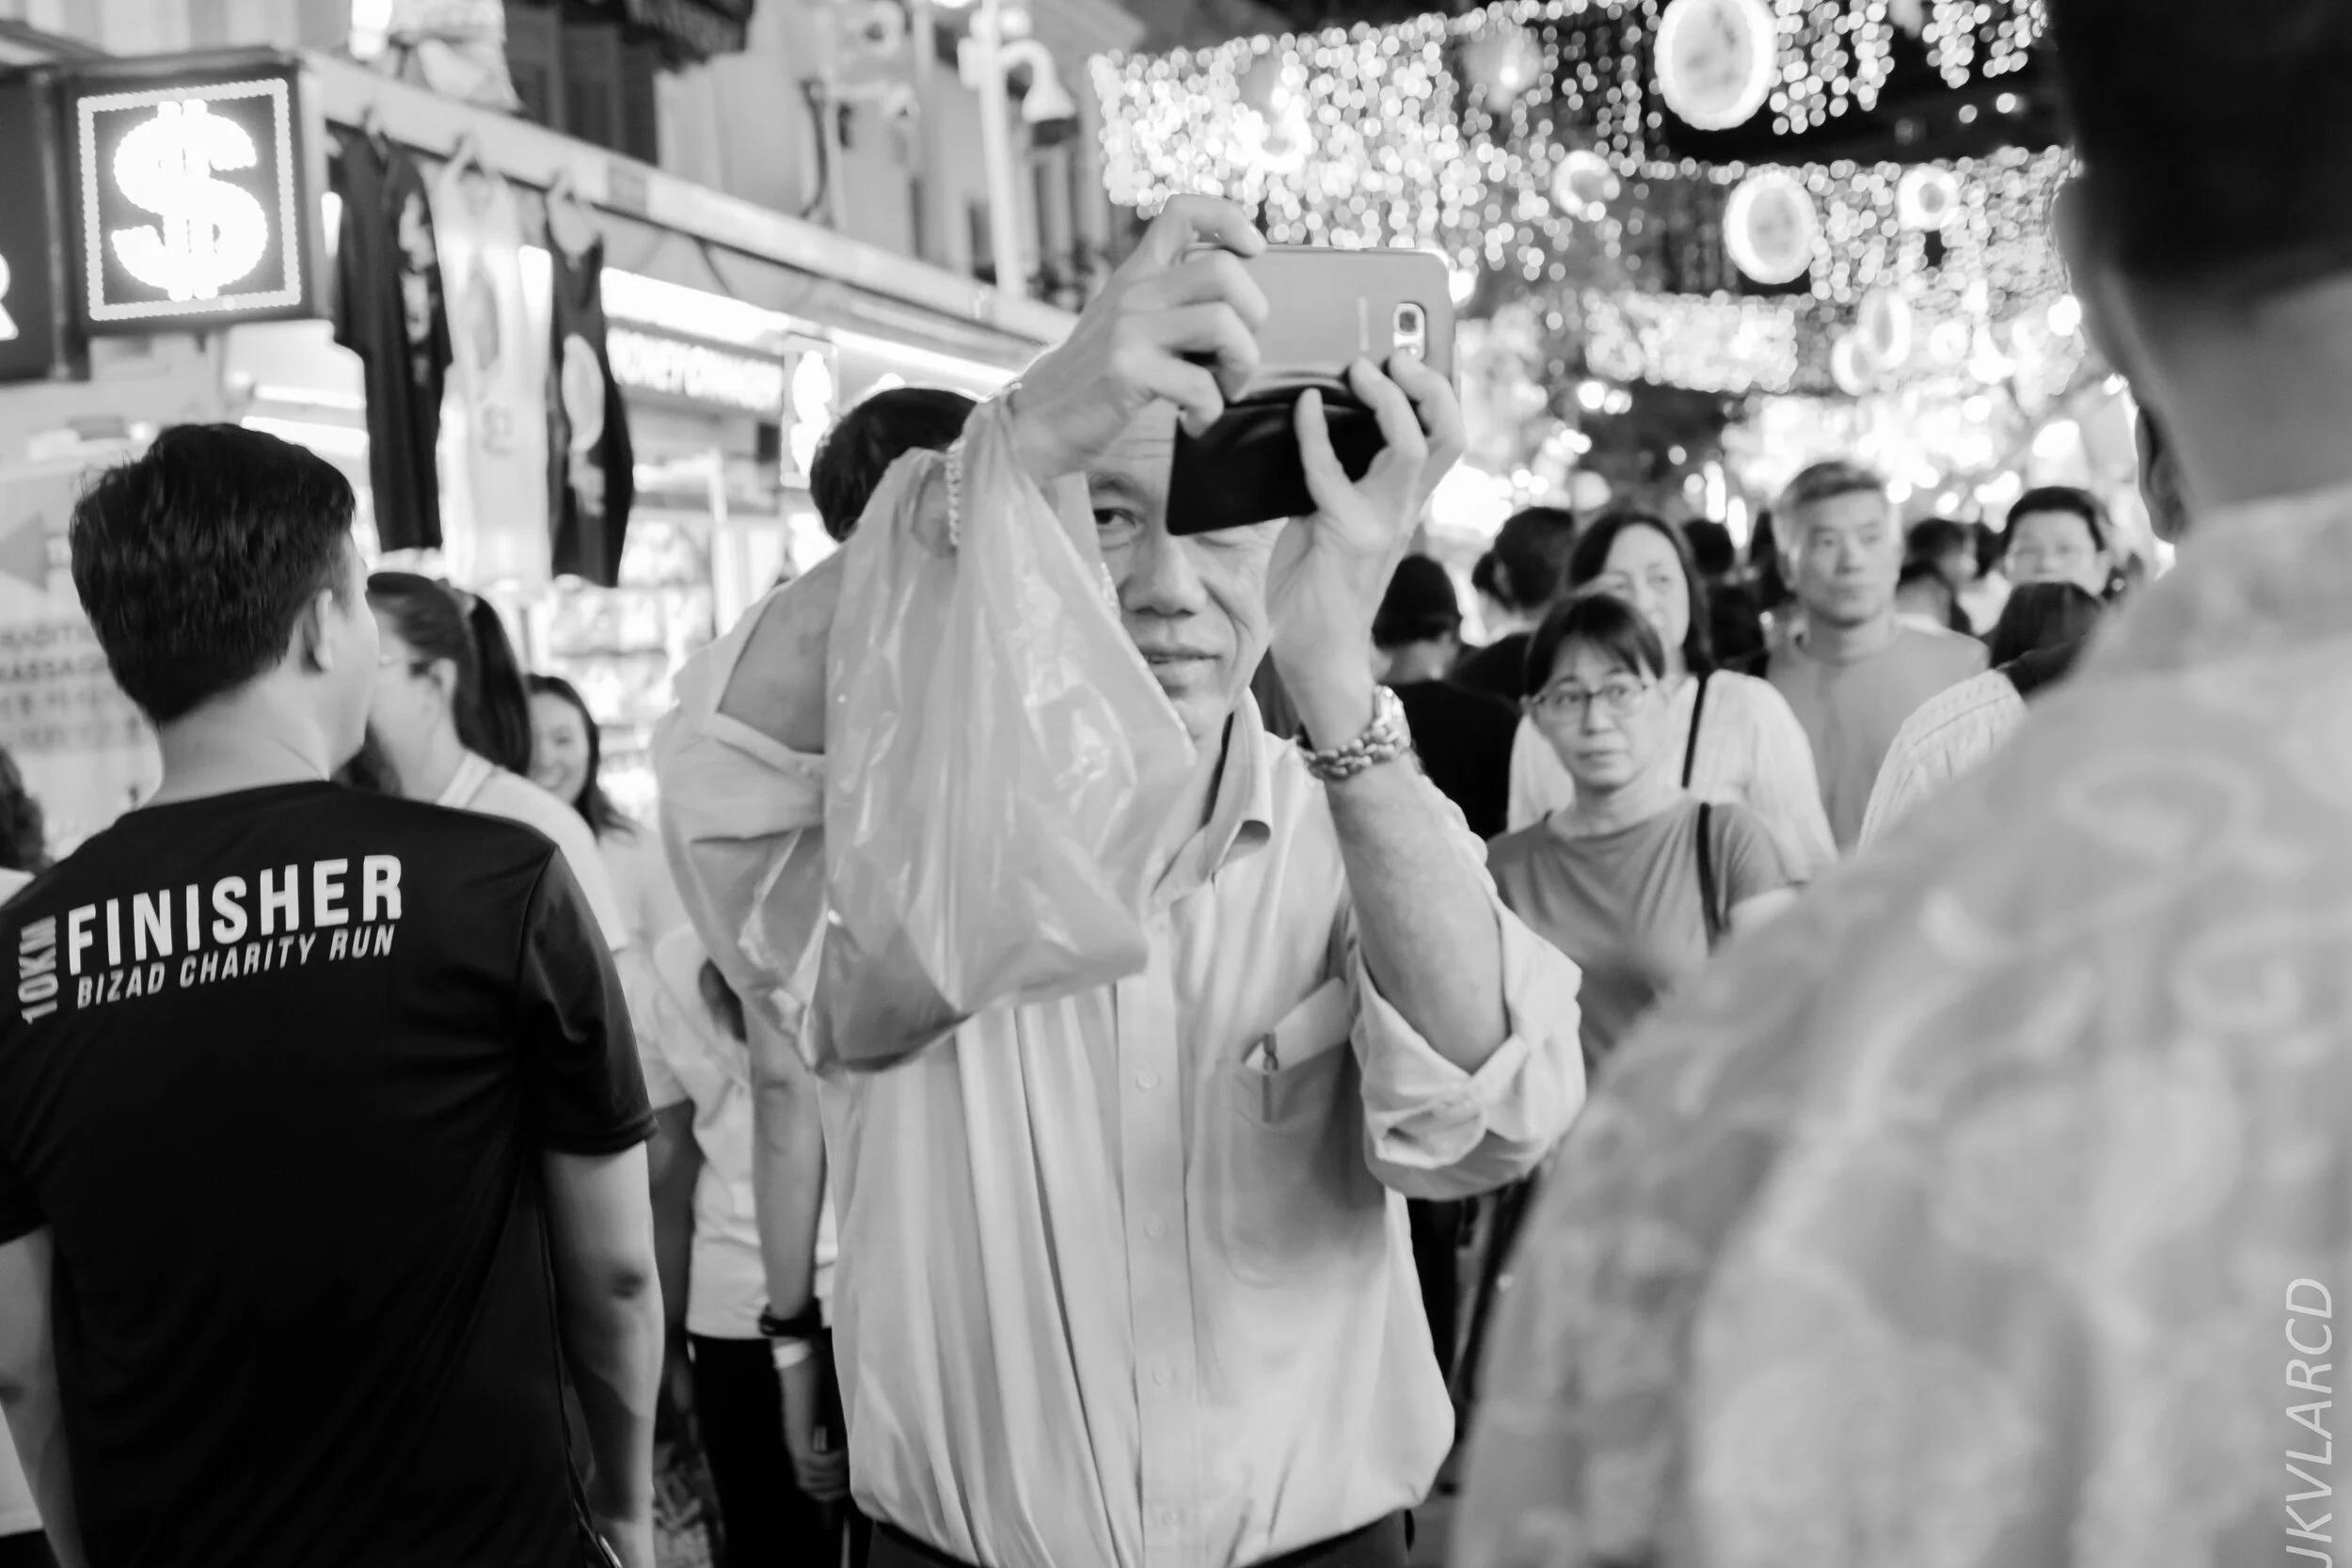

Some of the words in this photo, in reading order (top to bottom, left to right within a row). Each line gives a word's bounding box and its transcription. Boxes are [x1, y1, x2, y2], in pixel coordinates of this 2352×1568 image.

[17, 914, 58, 1024] 10KM
[68, 854, 402, 976] FINISHER
[77, 961, 165, 1009] BIZAD
[180, 932, 316, 988] CHARITY
[329, 924, 395, 961] RUN
